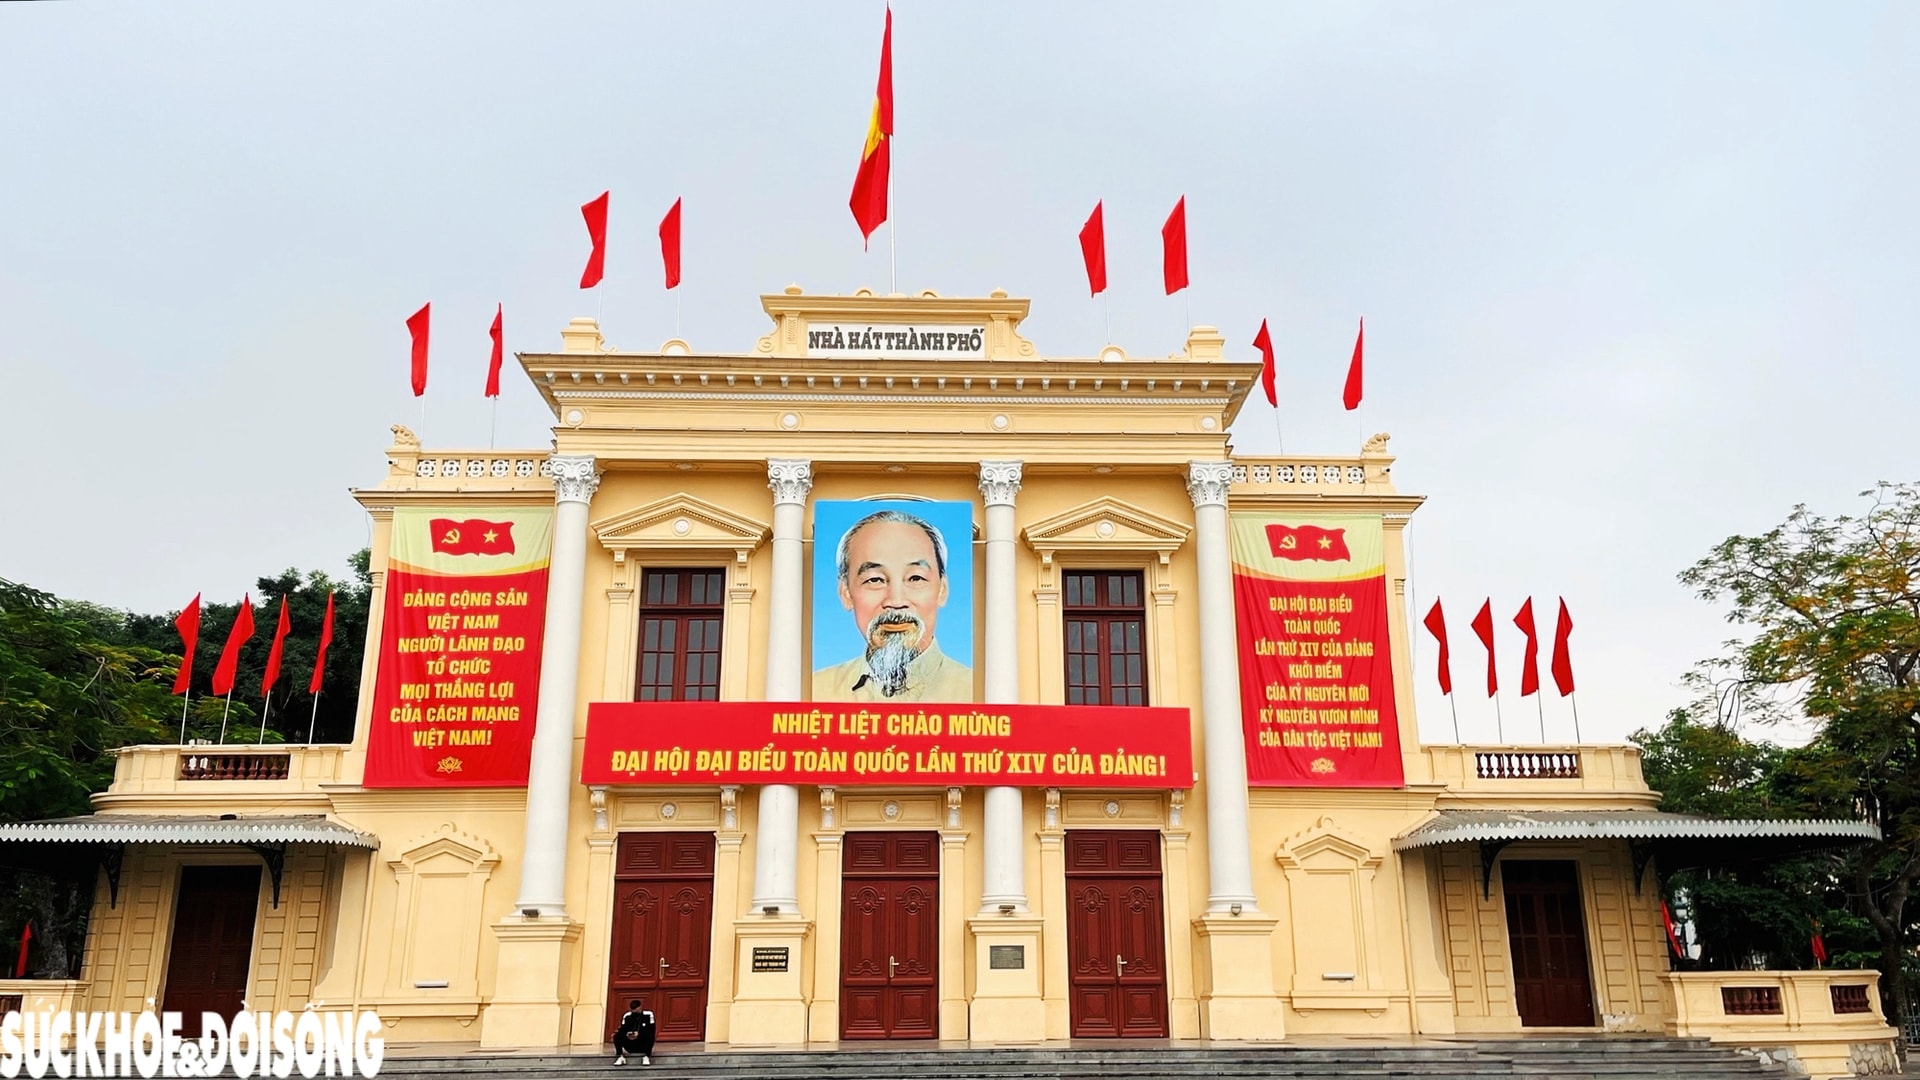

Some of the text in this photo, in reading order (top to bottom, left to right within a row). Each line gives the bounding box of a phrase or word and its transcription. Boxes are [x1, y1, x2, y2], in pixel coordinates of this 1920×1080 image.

[808, 326, 984, 351] NHÀ HÁT THÀNH PHỐ
[403, 587, 528, 609] ĐẢNG CỘNG SẢN
[1269, 597, 1287, 615] ĐẠI
[1290, 594, 1307, 615] HỘI
[1309, 597, 1326, 615] ĐẠI
[427, 612, 499, 632] VIỆT NAM
[1284, 616, 1341, 635] TOÀN QUỐC
[398, 634, 525, 654] NGƯỜI LÃNH ĐẠO
[1277, 638, 1297, 655] THỨ
[1299, 642, 1319, 656] XIV
[1322, 638, 1343, 656] CỦA
[1345, 637, 1374, 656] ĐẢNG
[427, 655, 491, 675] TỔ CHỨC
[1289, 660, 1313, 678] KHỞI
[400, 677, 514, 702] MỌI THẮNG LỢI
[1266, 681, 1369, 702] CỦA KỶ NGUYÊN MỚI
[390, 703, 520, 724] CỦA CÁCH MẠNG
[1260, 704, 1379, 724] KỶ NGUYÊN VƯƠN MÌNH
[772, 710, 1011, 740] NHIỆT LIỆT CHÀO MỪNG
[413, 728, 492, 749] VIỆT NAM!
[1259, 727, 1280, 747] CỦA
[1283, 729, 1305, 747] DÂN
[1306, 730, 1327, 751] TỘC
[1329, 730, 1351, 751] VIỆT
[611, 750, 648, 776] ĐẠI
[654, 746, 690, 776] HỘI
[696, 750, 732, 776] ĐẠI
[737, 742, 786, 772] BIỂU
[792, 747, 847, 772] TOÀN
[853, 745, 909, 774] QUỐC
[916, 745, 956, 773] LẦN
[962, 748, 1003, 774] THỨ
[1007, 753, 1047, 774] XIV
[1053, 747, 1094, 775] CỦA
